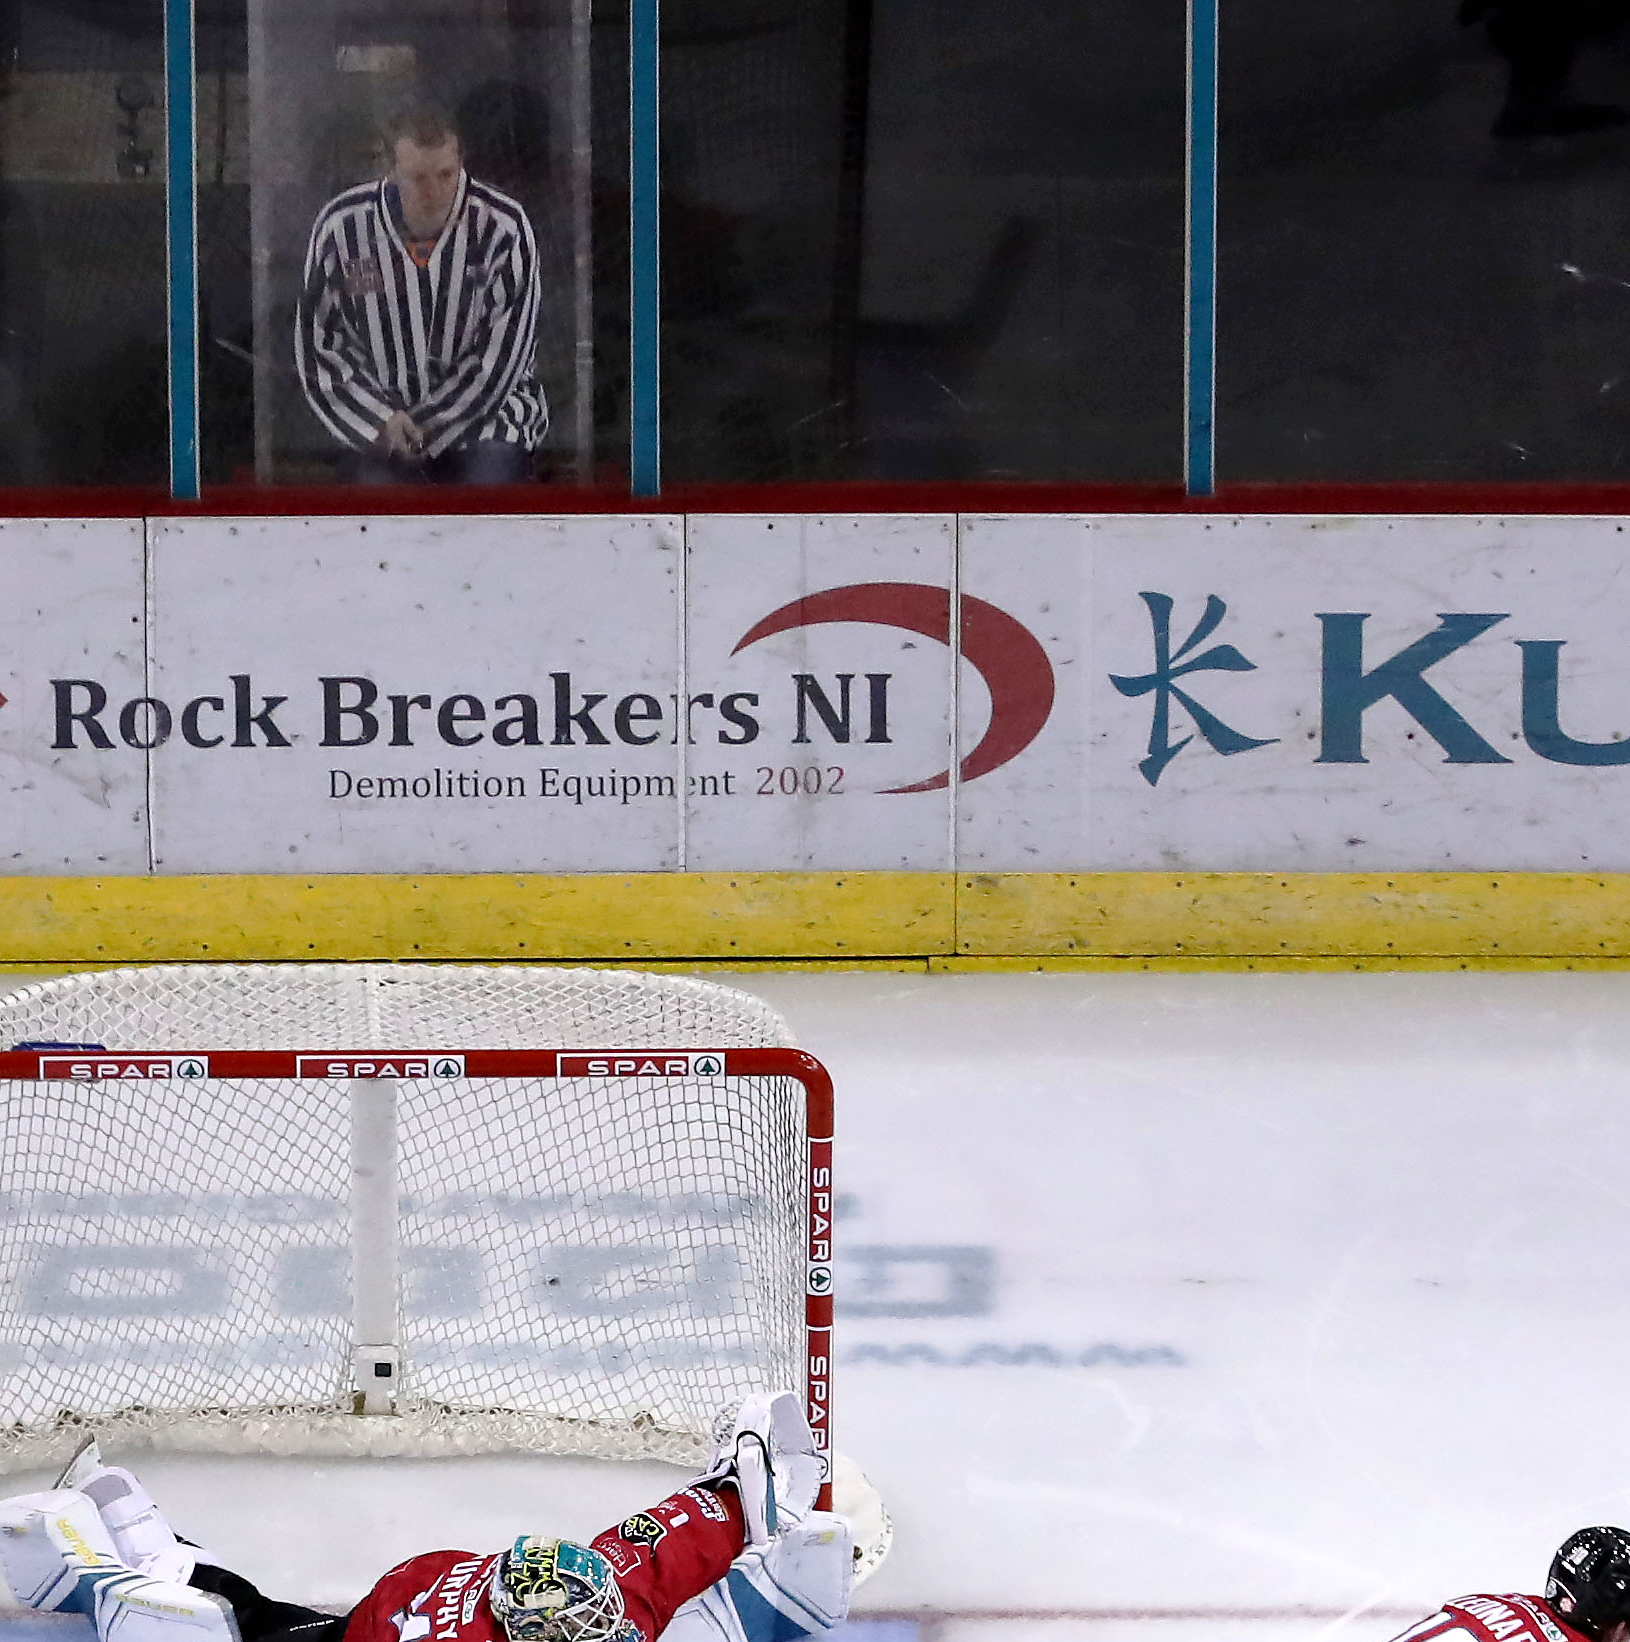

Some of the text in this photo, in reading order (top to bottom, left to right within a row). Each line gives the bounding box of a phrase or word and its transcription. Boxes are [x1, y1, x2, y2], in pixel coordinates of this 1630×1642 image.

[50, 672, 894, 748] Rock Breakers NI
[328, 765, 846, 804] Demolition Equipment 2002
[70, 1063, 170, 1079] SPAR
[326, 1062, 428, 1079] SPAR
[586, 1059, 688, 1077] SPAR
[812, 1167, 831, 1261] SPAR
[436, 1556, 486, 1640] URPHY
